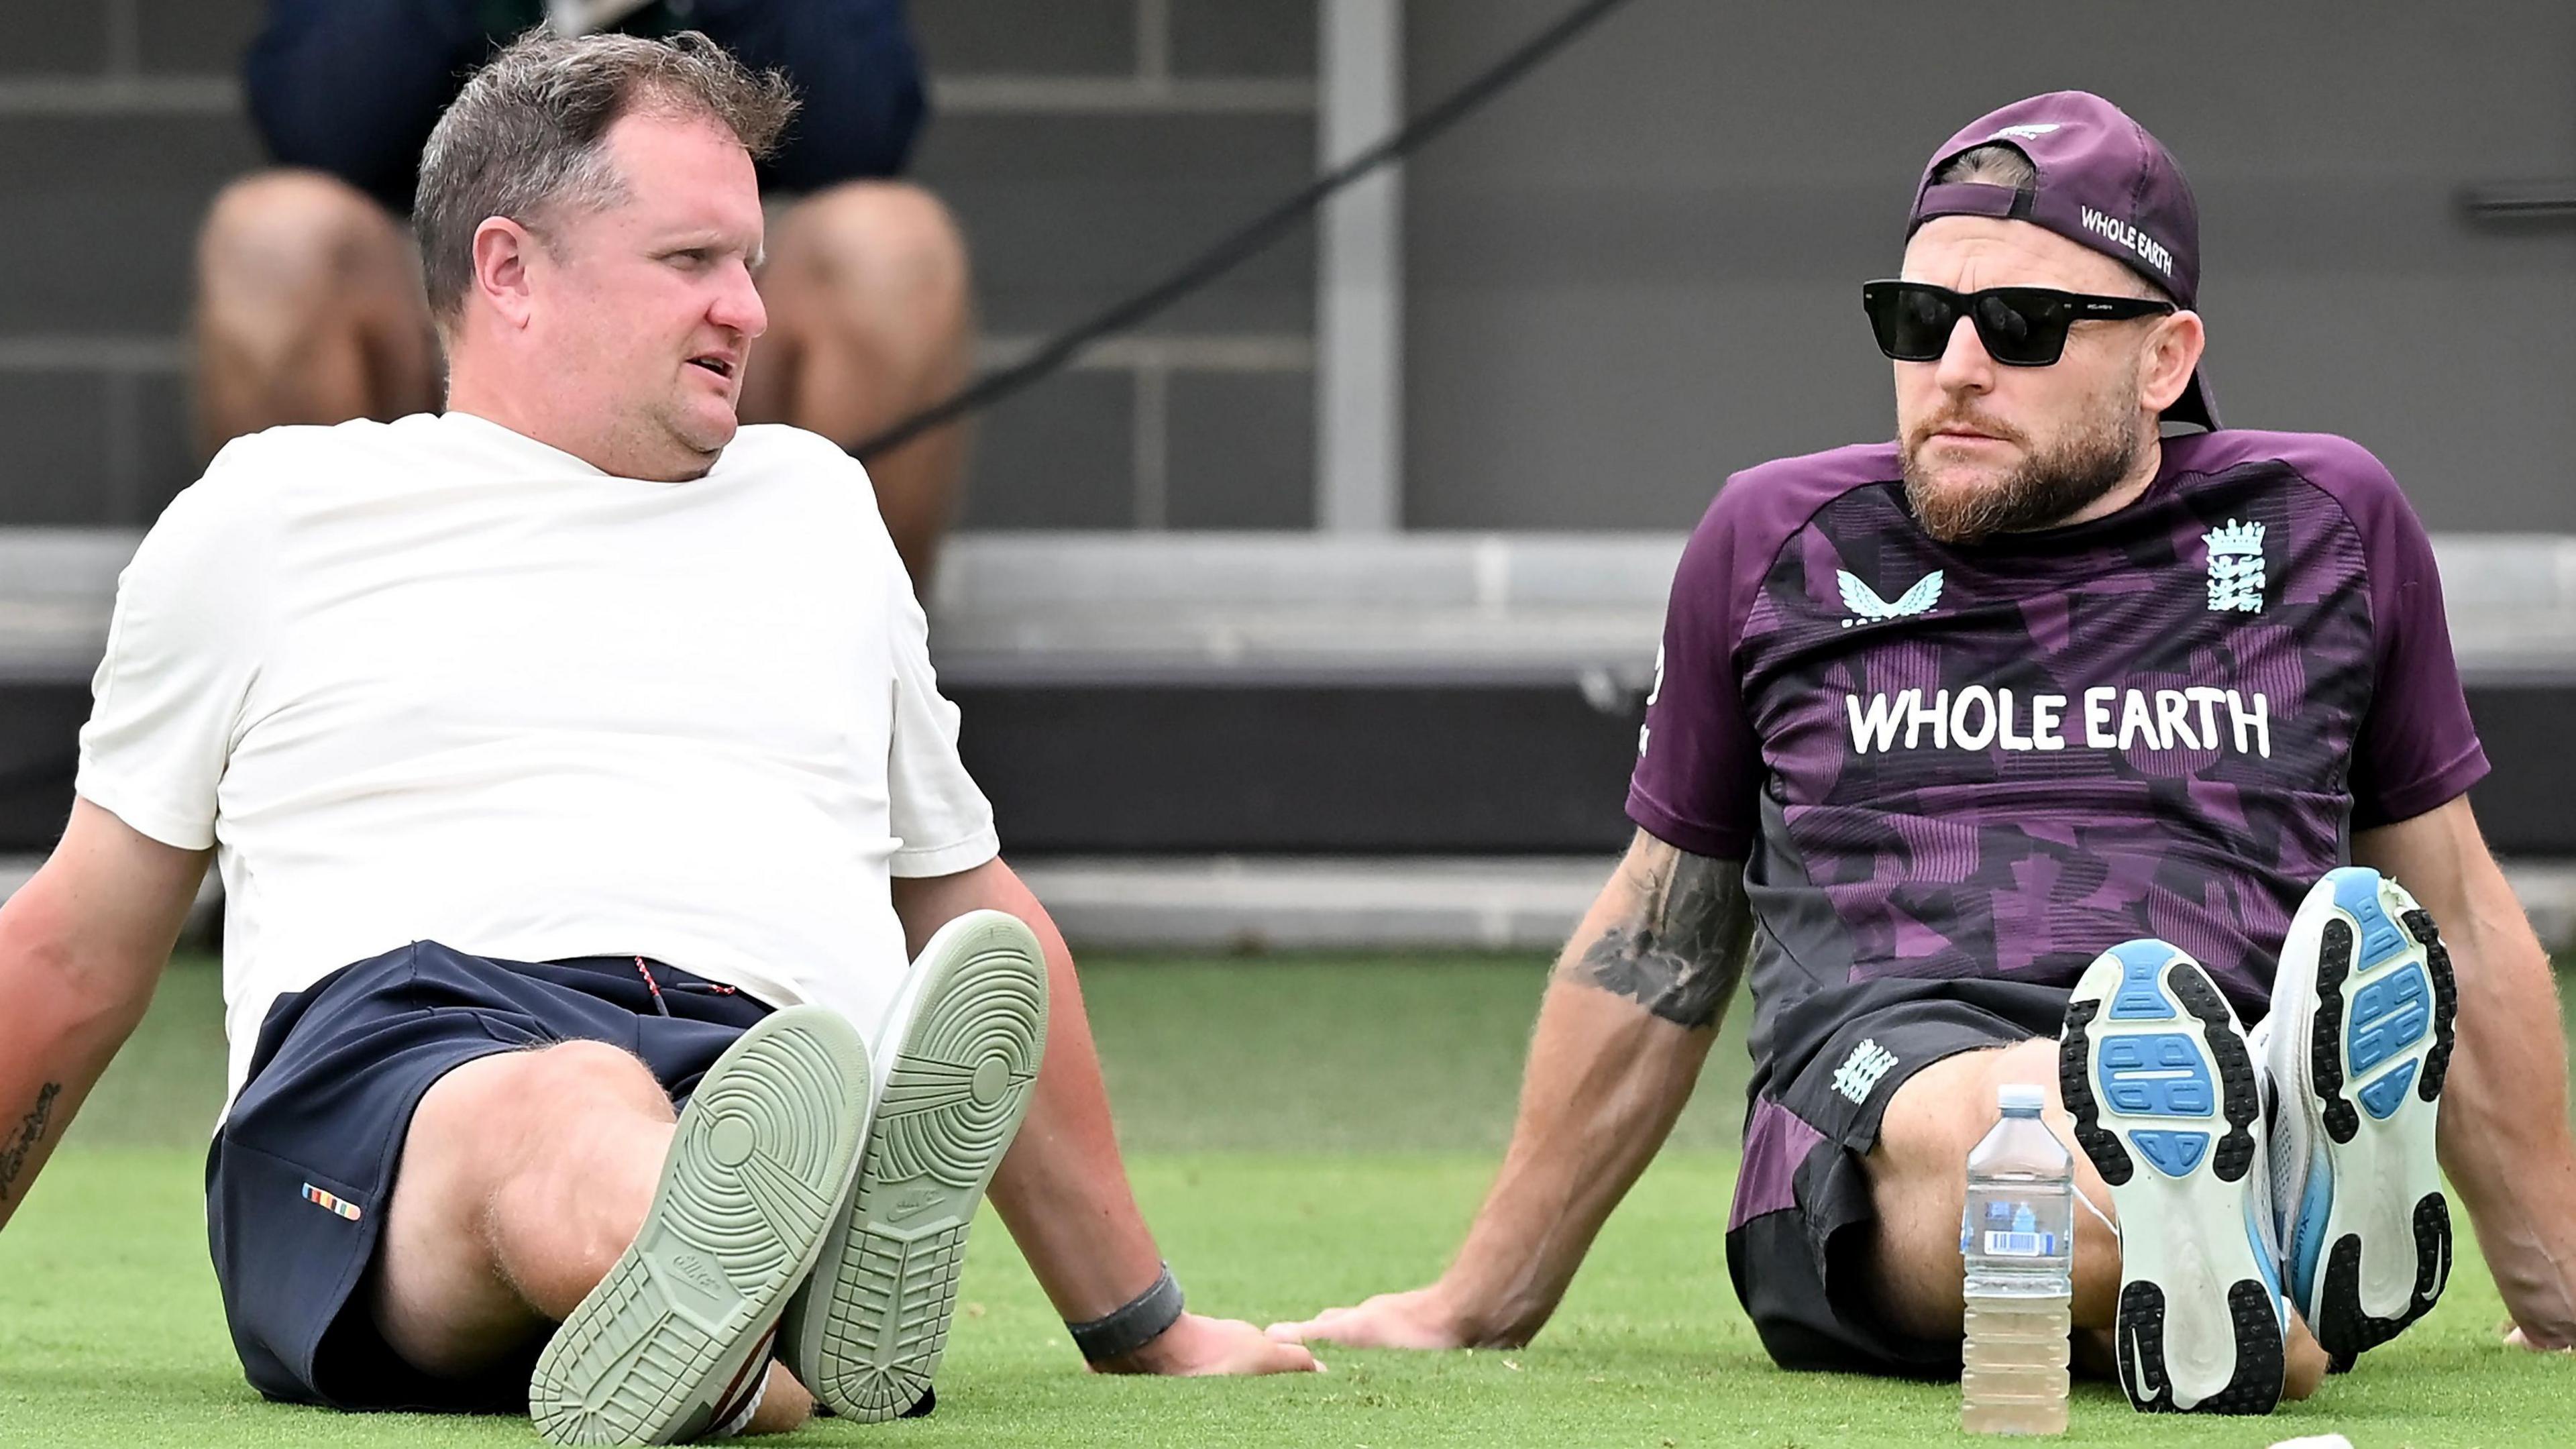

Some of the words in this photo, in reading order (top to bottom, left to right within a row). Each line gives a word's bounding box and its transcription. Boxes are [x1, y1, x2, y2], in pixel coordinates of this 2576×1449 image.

[2082, 205, 2137, 250] WHOLE
[2137, 232, 2173, 278] EARTH
[1845, 686, 2066, 753] WHOLE
[2084, 687, 2270, 758] EARTH
